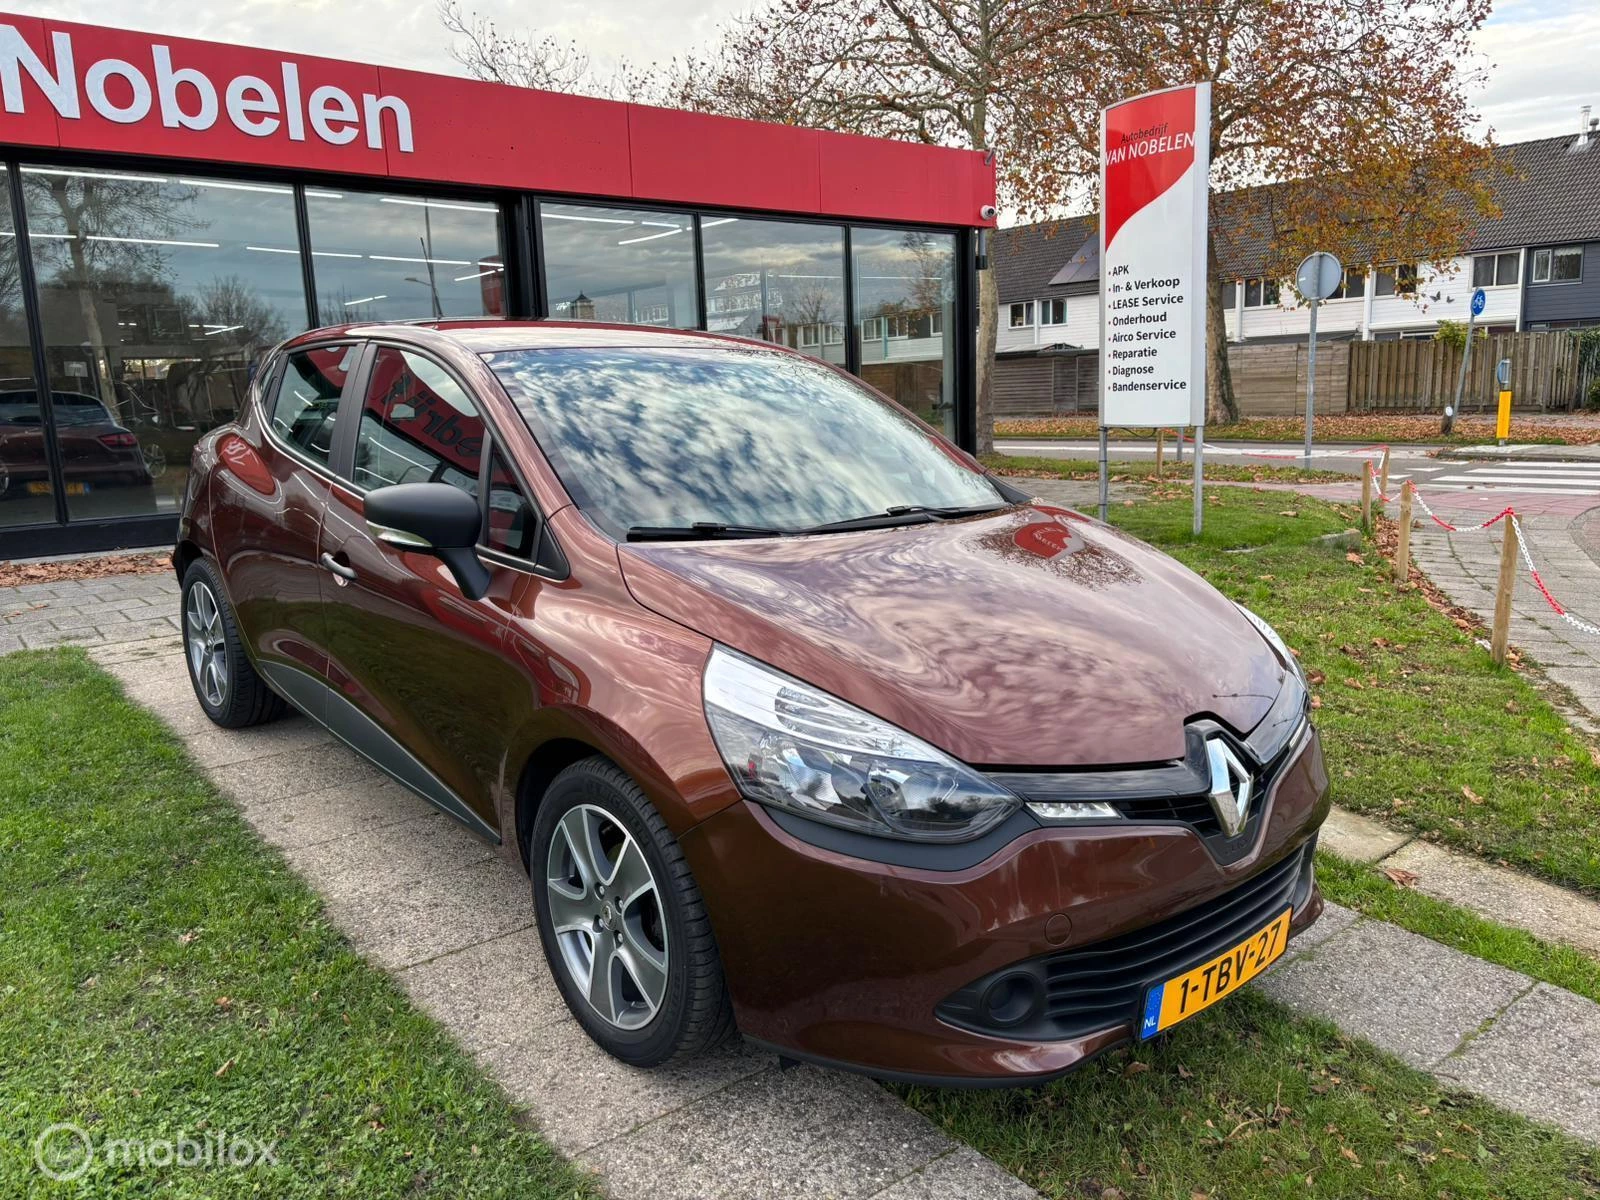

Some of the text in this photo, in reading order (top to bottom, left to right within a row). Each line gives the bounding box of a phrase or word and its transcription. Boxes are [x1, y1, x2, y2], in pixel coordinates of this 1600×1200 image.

[0, 24, 414, 153] Nobelen
[1121, 123, 1168, 144] Autobedrijf
[1105, 132, 1195, 166] VAN NOBELEN
[1112, 265, 1129, 276] APK
[1112, 278, 1180, 293] In- & Verkoop
[1112, 294, 1184, 309] LEASE Service
[1112, 312, 1167, 326] Onderhoud
[1112, 328, 1176, 343] Airco Service
[1112, 346, 1157, 360] Reparatie
[1112, 365, 1154, 377] Diagnose
[1112, 379, 1187, 392] Bandenservice
[1180, 920, 1281, 1014] 1-TBV-27
[1143, 1016, 1156, 1029] NL
